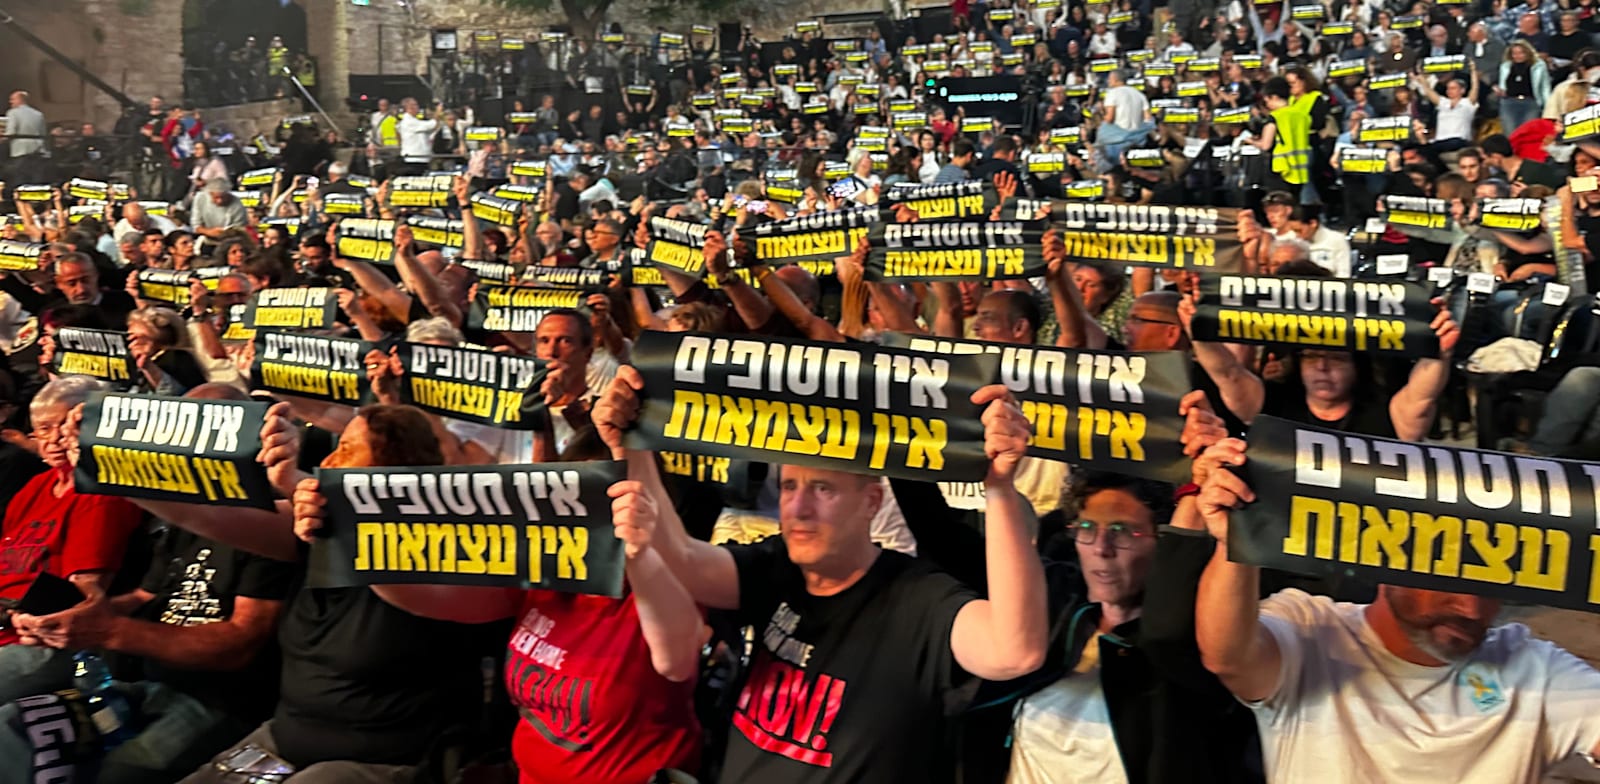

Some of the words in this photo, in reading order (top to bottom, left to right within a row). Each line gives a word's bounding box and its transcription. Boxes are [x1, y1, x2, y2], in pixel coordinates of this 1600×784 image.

[884, 222, 980, 247] חטופים
[985, 222, 1024, 248] אין
[1066, 203, 1169, 232] חטופים
[1175, 207, 1218, 236] אין
[883, 249, 982, 277] עצמאות
[986, 248, 1025, 277] אין
[1064, 232, 1168, 262] עצמאות
[1173, 236, 1215, 267] אין
[1220, 276, 1347, 312] חטופים
[1353, 282, 1406, 317] אין
[1218, 310, 1347, 346] עצמאות
[1353, 318, 1406, 350] אין
[331, 340, 359, 370] אין
[411, 345, 496, 383] חטופים
[674, 335, 861, 400] חטופים
[330, 371, 359, 400] אין
[411, 377, 494, 417] עצמאות
[873, 352, 949, 410] אין
[1077, 353, 1146, 404] אין
[96, 396, 199, 447] חטופים
[194, 404, 244, 454] אין
[663, 390, 860, 460] עצמאות
[869, 409, 948, 470] אין
[1077, 407, 1147, 461] אין
[92, 445, 200, 494] עצמאות
[192, 457, 248, 500] אין
[1296, 429, 1571, 518] חטופים
[343, 473, 512, 515] חטופים
[513, 471, 588, 521] אין
[354, 523, 517, 575] עצמאות
[526, 525, 589, 583] אין
[1283, 495, 1571, 592] עצמאות
